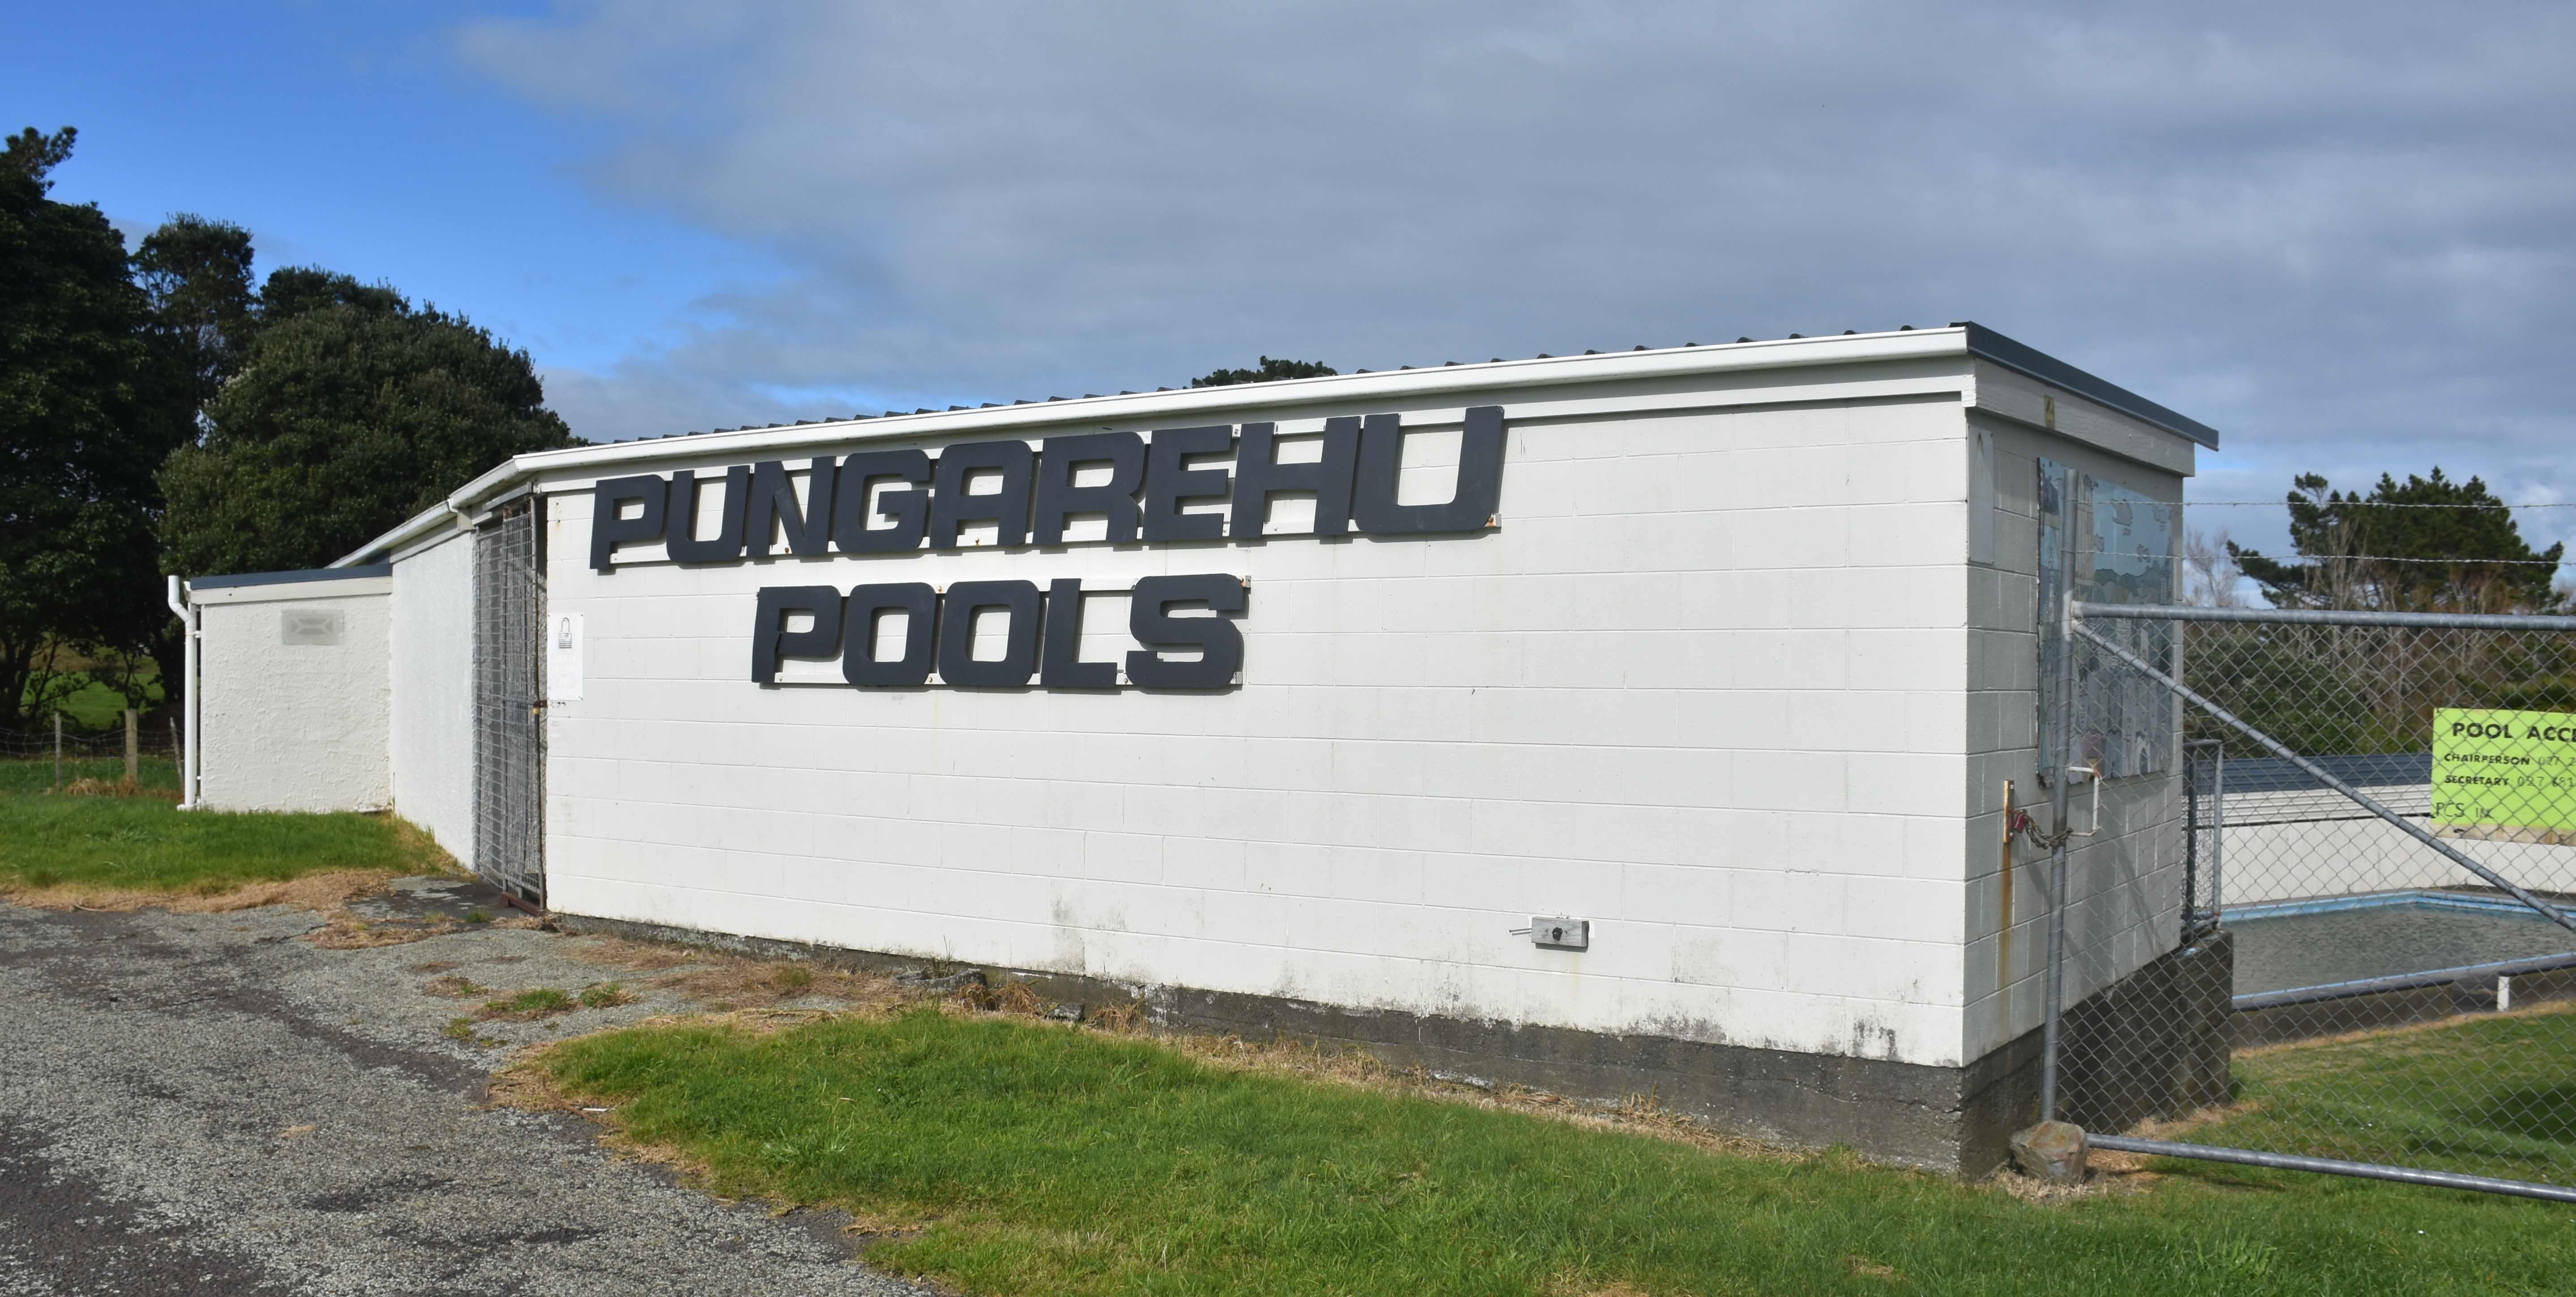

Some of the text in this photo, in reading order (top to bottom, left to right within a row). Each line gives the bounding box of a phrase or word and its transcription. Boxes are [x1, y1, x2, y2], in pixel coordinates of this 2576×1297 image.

[590, 406, 1504, 569] PUNGAREHU
[752, 574, 1243, 688] POOLS
[2452, 722, 2513, 739] POOL
[2444, 753, 2529, 765] CHAIRPERSON
[2444, 775, 2508, 786] SECRETARY
[2436, 802, 2464, 817] PCS
